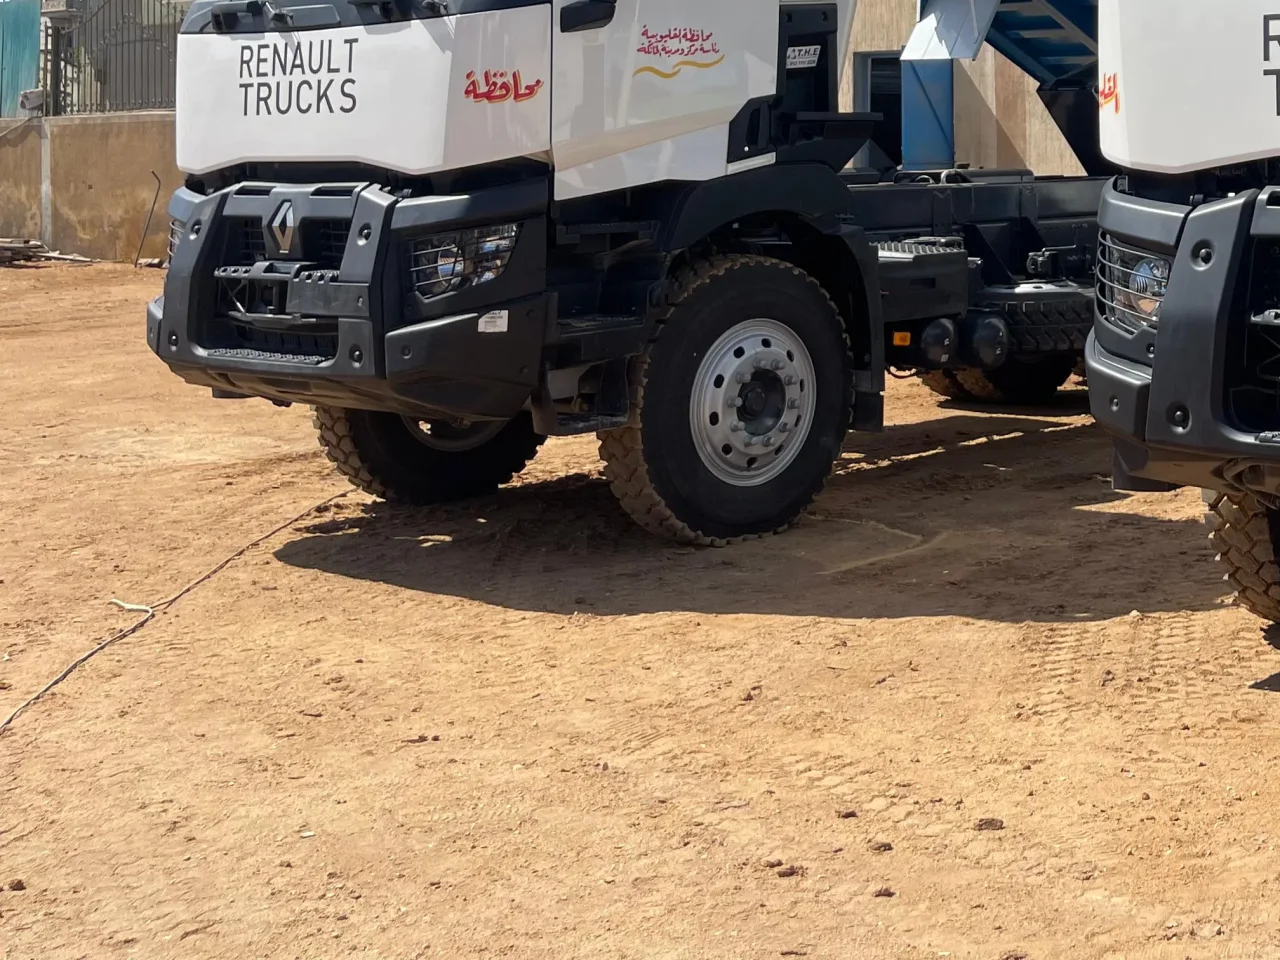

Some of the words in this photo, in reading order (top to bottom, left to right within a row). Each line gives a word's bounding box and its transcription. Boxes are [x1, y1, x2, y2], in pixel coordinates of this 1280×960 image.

[682, 27, 713, 42] محافظة
[240, 38, 359, 79] RENAULT
[239, 78, 357, 117] TRUCKS
[464, 68, 544, 104] محافظة
